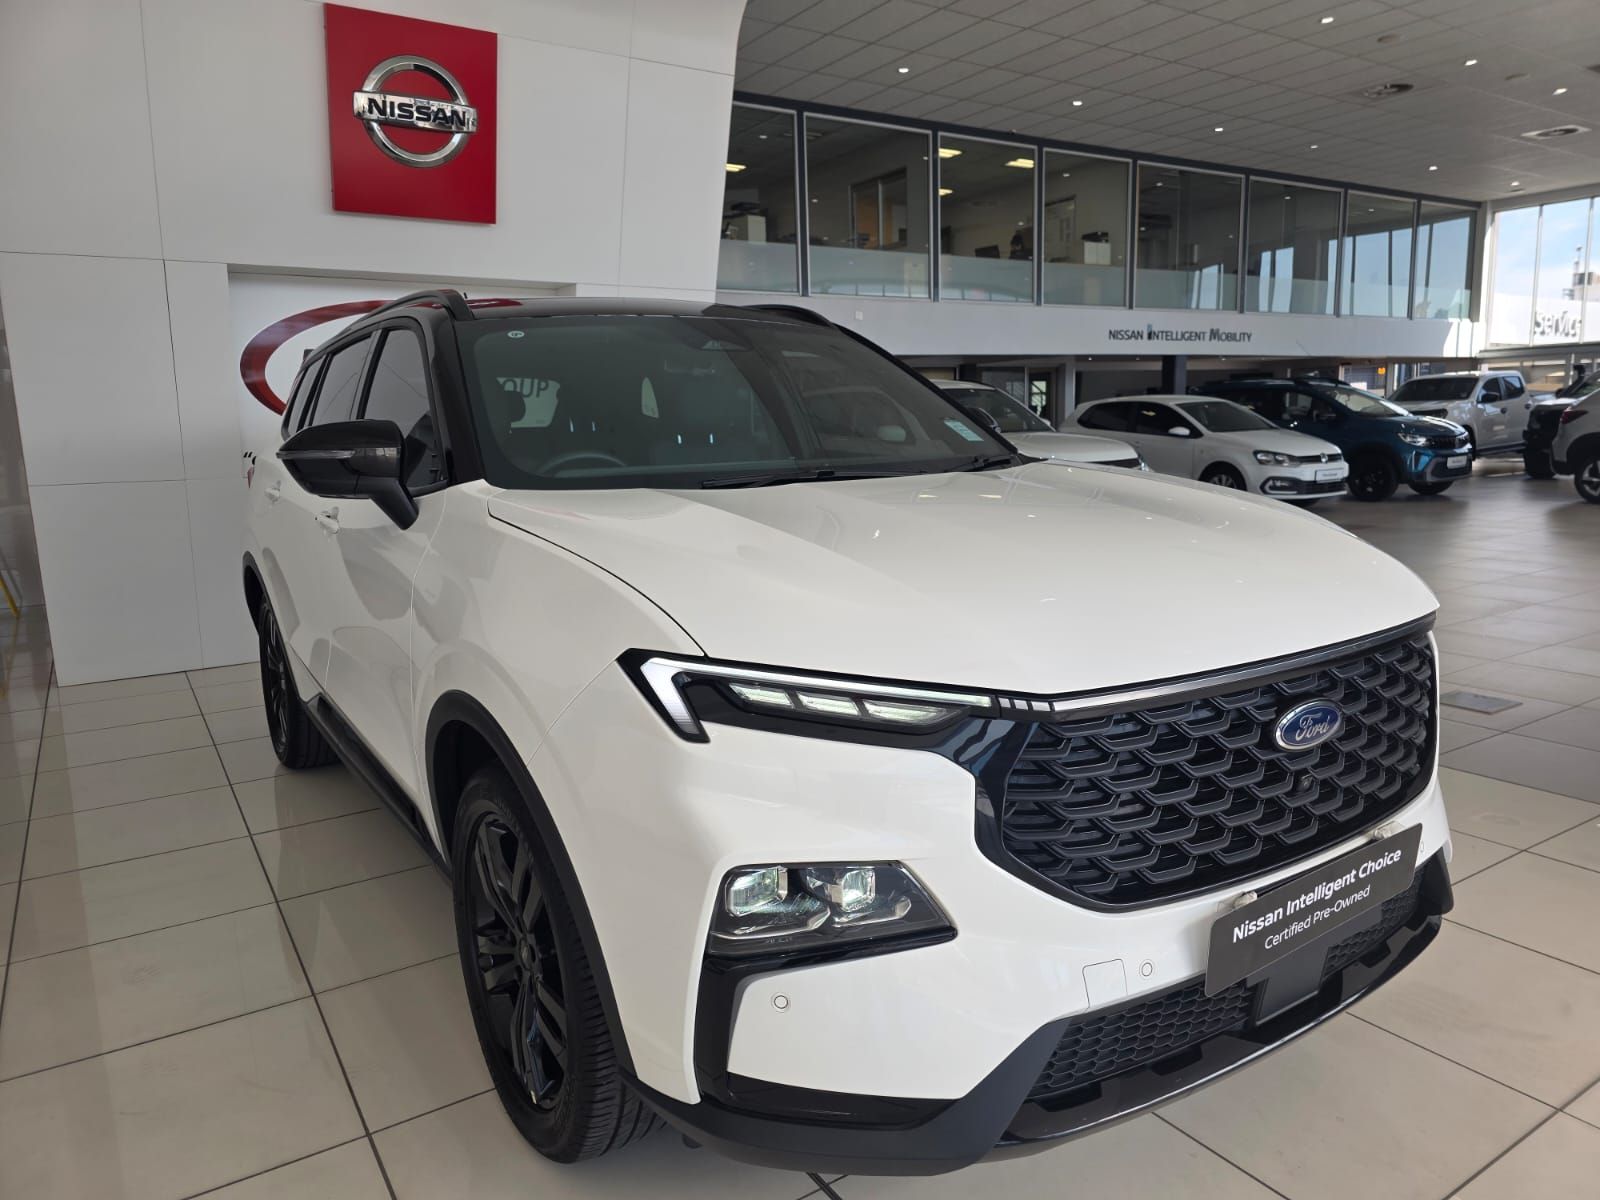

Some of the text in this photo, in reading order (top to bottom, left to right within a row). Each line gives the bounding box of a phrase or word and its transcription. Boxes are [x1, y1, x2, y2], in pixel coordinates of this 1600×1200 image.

[367, 97, 466, 127] NISSAN
[1108, 323, 1252, 342] NISSAN INTELLIGENT MOBILITY
[1295, 712, 1330, 741] Ford
[1232, 849, 1402, 943] Nissan Intelligent Choice
[1264, 884, 1371, 949] Certified Pre-Owned
